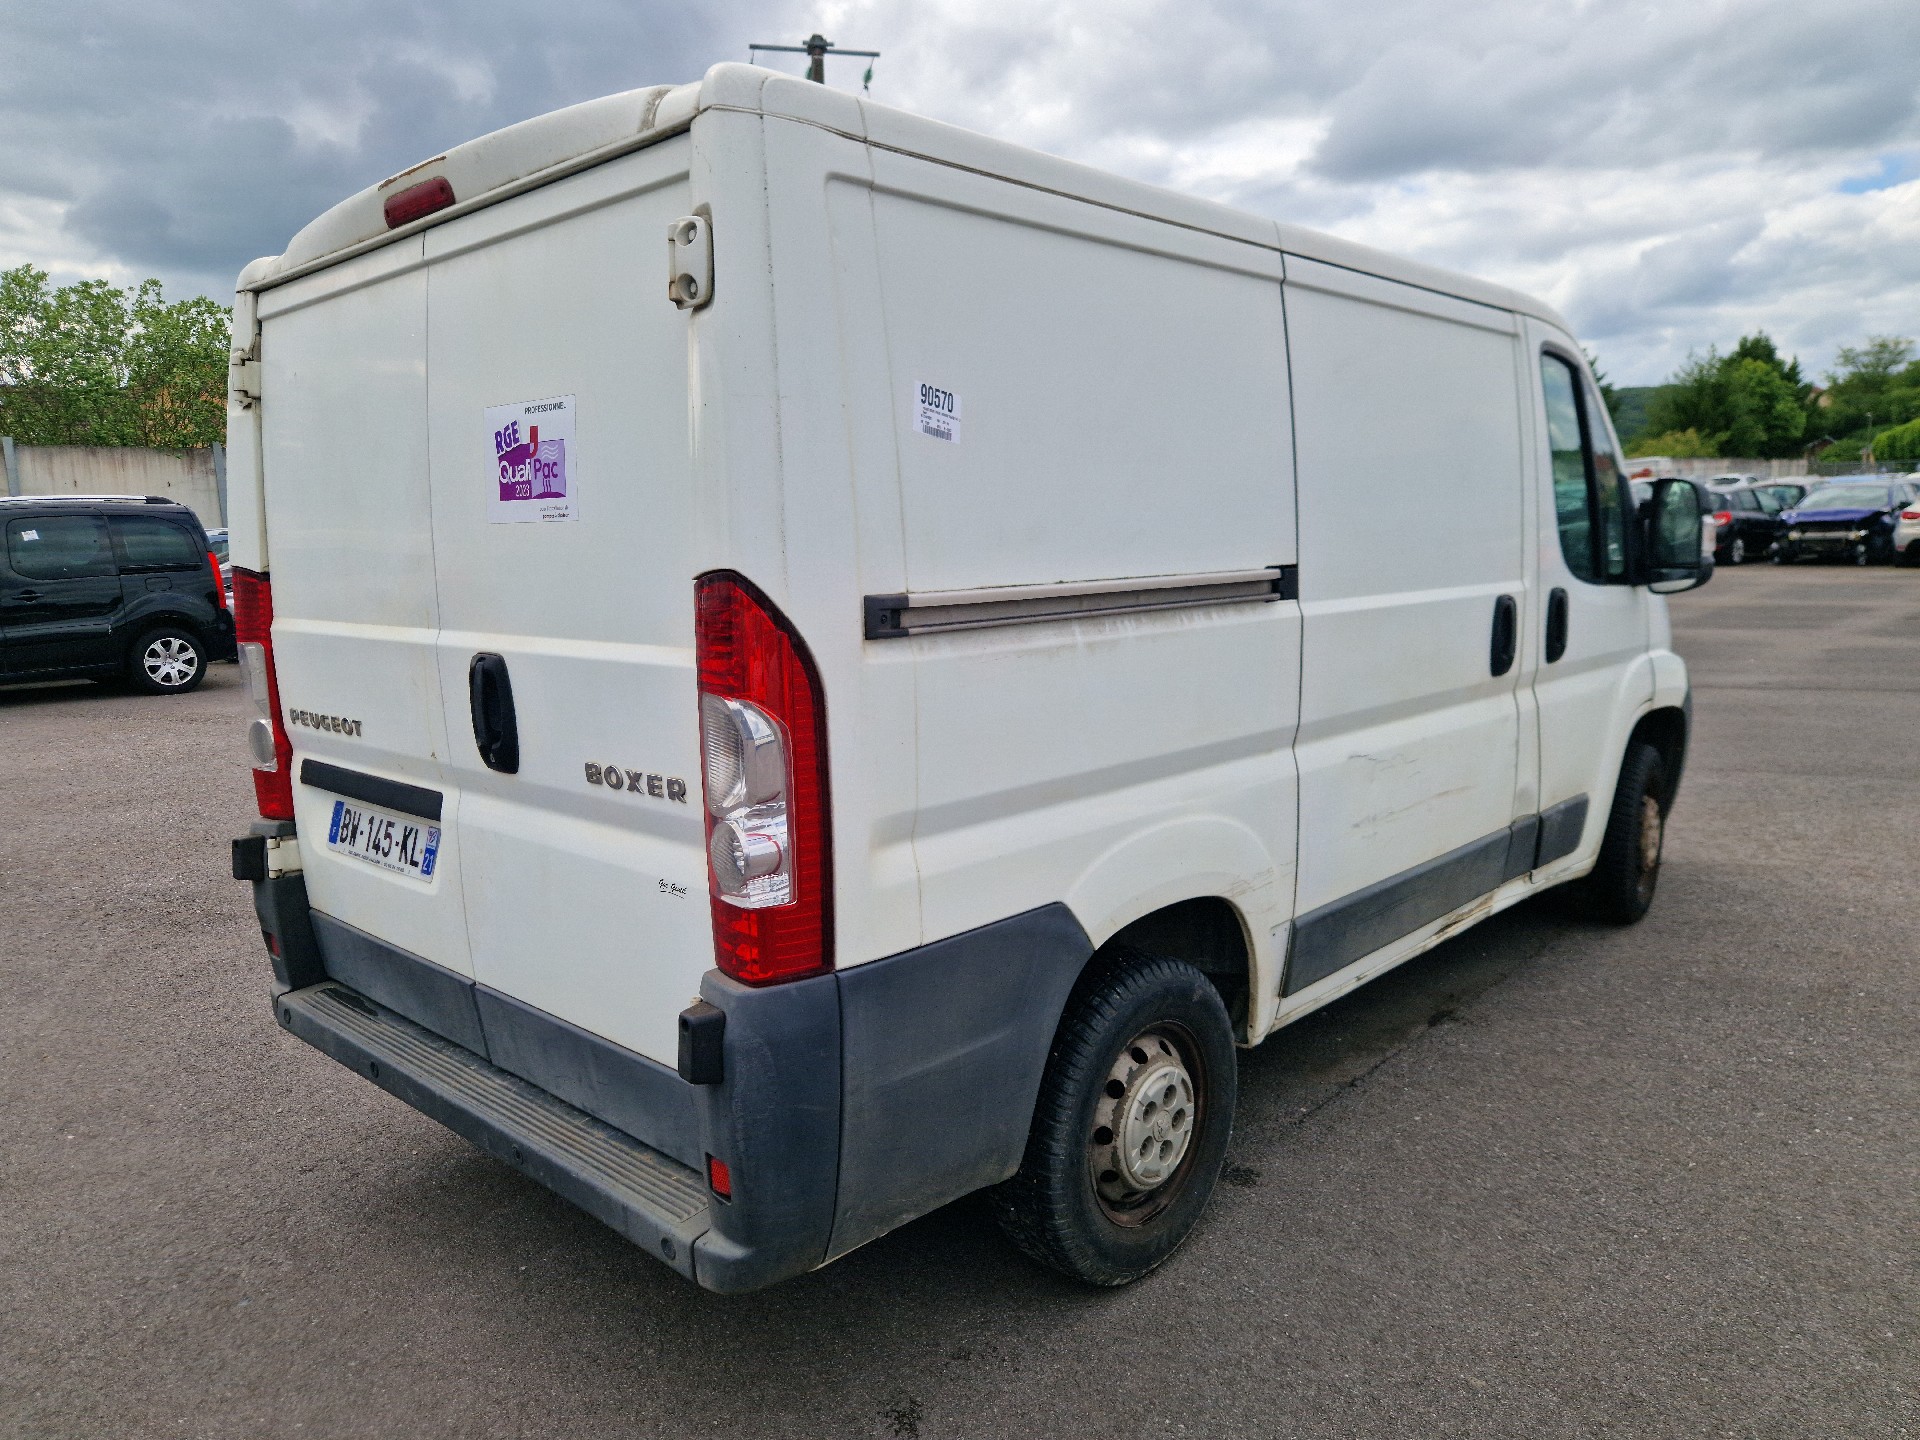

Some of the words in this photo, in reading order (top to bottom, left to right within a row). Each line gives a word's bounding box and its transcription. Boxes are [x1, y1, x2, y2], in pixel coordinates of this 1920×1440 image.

[920, 383, 954, 413] 90570
[494, 420, 520, 455] RGE
[289, 708, 362, 737] PEUGEOT
[584, 762, 687, 804] BOXER
[422, 853, 435, 872] 21
